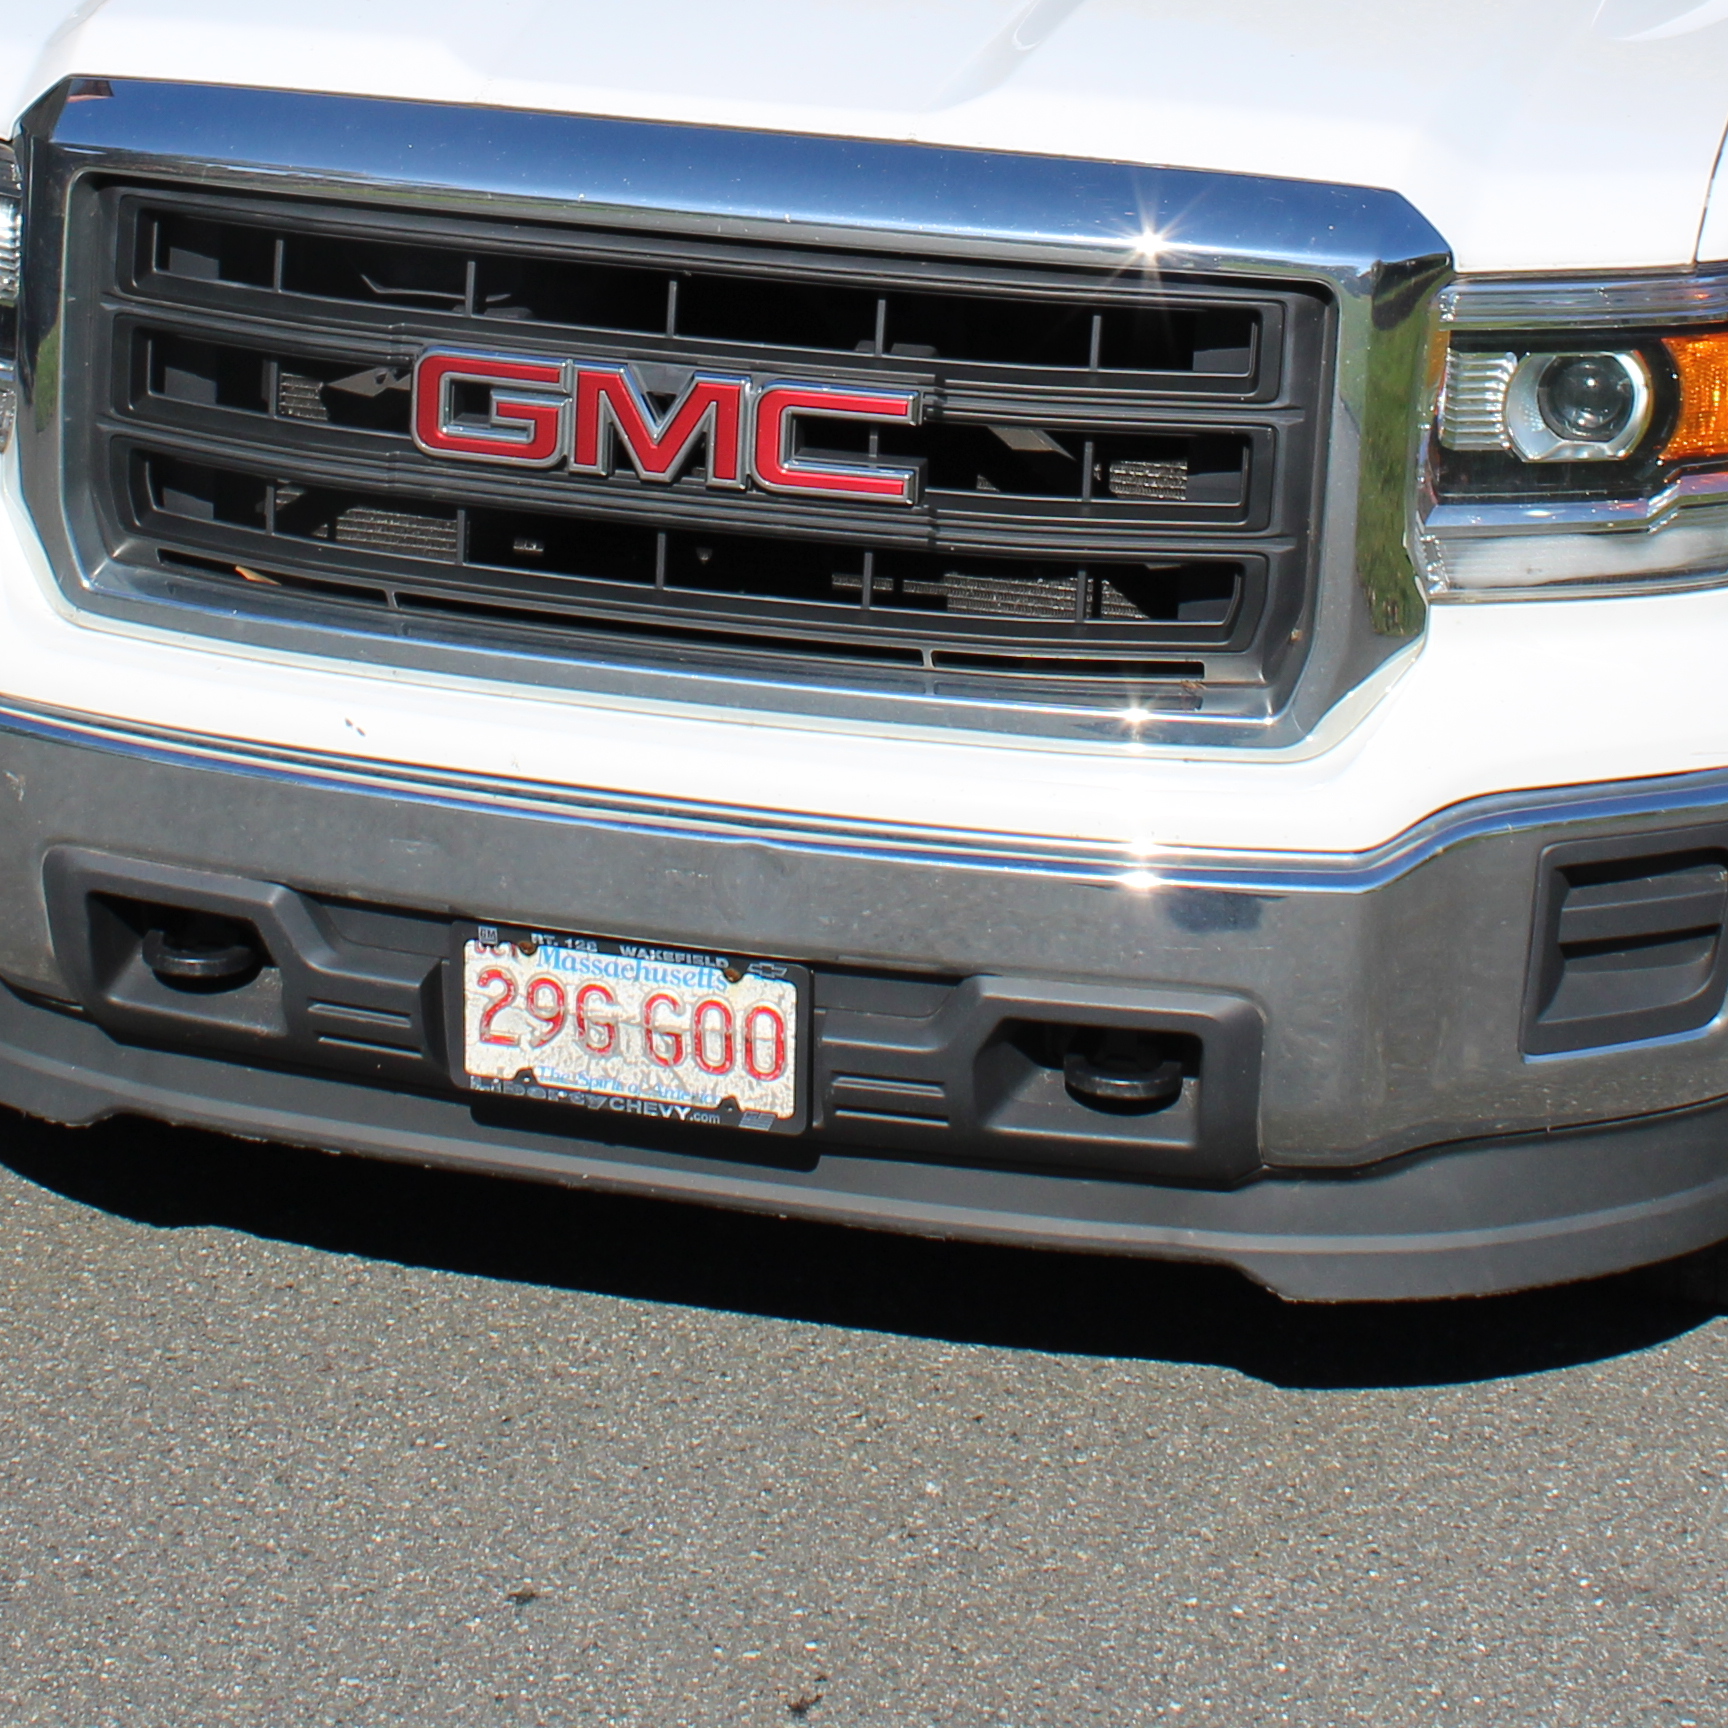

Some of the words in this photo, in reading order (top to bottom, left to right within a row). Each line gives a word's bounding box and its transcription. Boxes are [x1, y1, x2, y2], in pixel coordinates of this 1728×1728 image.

[411, 346, 927, 506] GMC
[531, 932, 559, 946] RT.
[619, 944, 729, 969] WAKEFIELD
[536, 946, 729, 992] Massachusetts
[476, 969, 617, 1055] 29G
